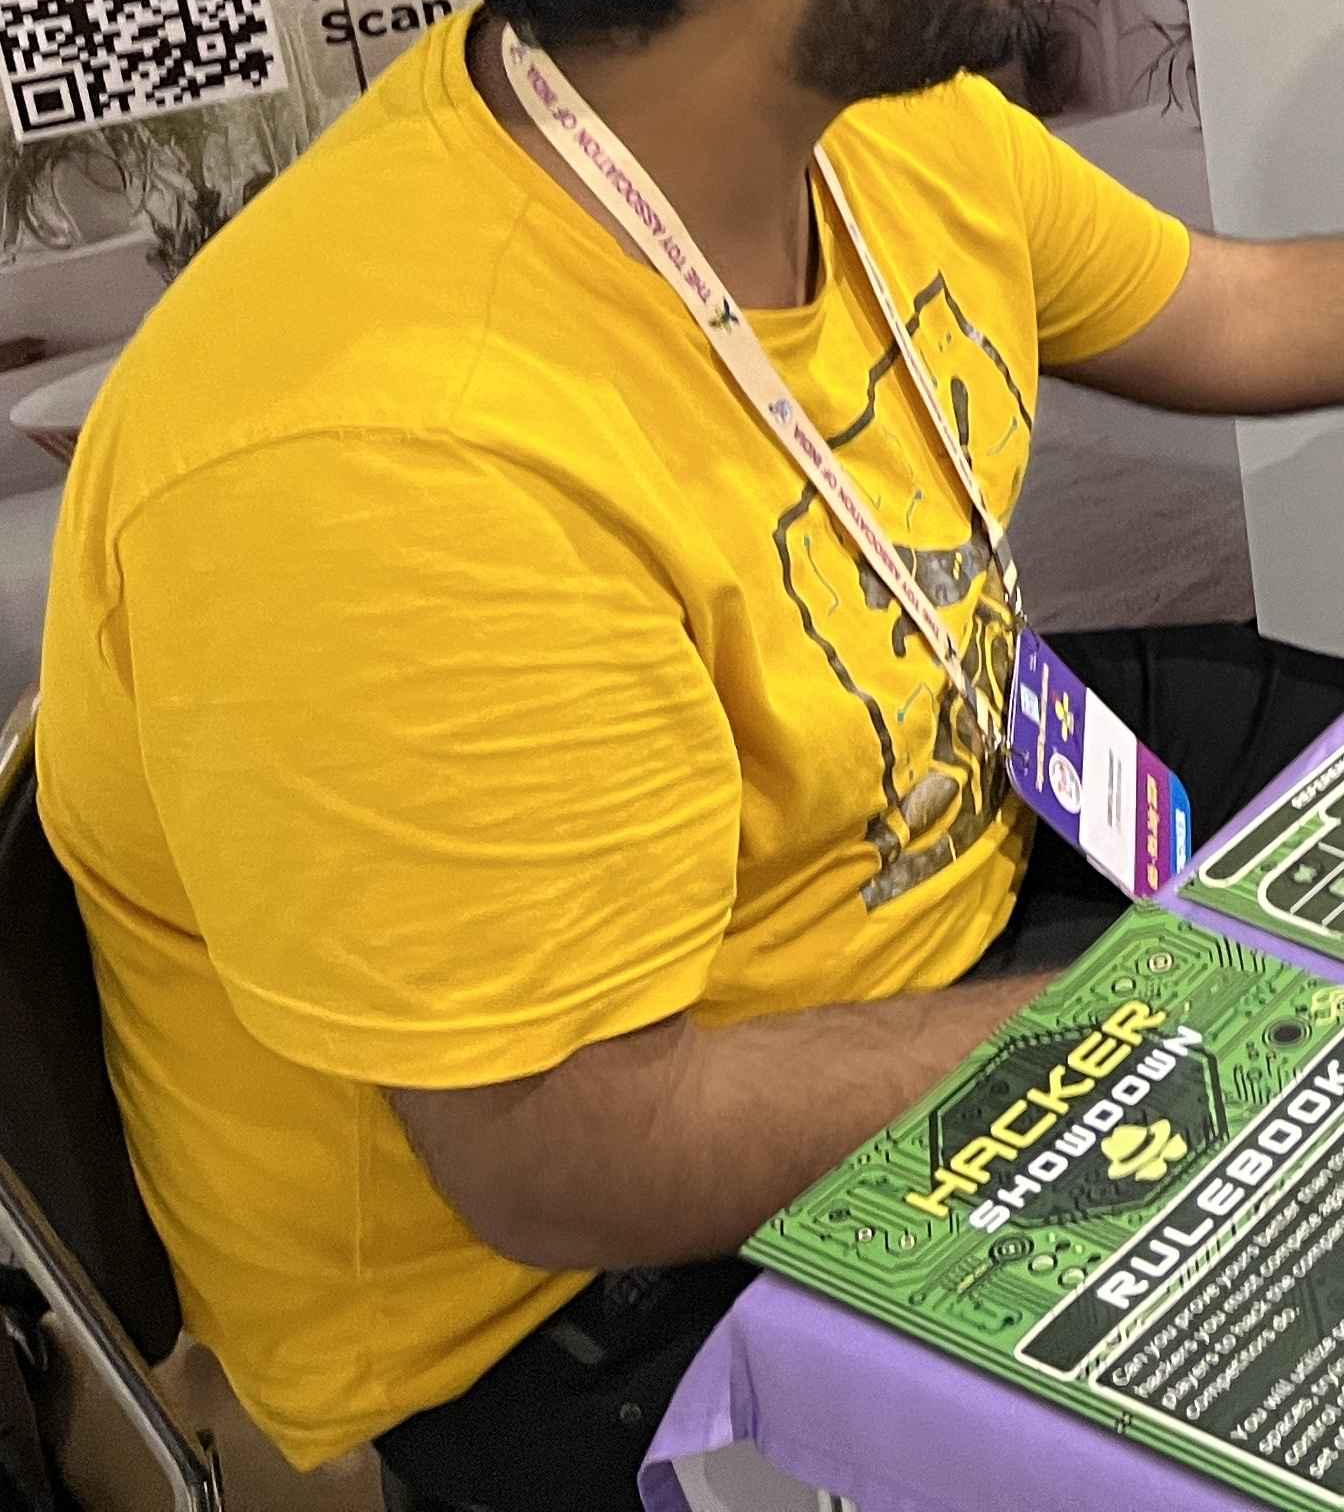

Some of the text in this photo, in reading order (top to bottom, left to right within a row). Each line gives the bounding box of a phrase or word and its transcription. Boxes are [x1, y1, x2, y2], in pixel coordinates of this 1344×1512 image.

[551, 106, 578, 129] OF
[576, 128, 667, 237] ASSOCIATION
[661, 235, 686, 271] TOY
[683, 266, 711, 305] THE
[908, 1000, 1164, 1219] HACKER
[969, 1024, 1202, 1233] SHOWDOWN
[1111, 1352, 1149, 1387] Can
[1143, 1324, 1178, 1360] you
[1173, 1283, 1221, 1331] prove
[1252, 1199, 1300, 1248] better
[1297, 1168, 1334, 1204] than
[1132, 1339, 1198, 1399] hackers
[1193, 1309, 1227, 1346] you
[1222, 1273, 1264, 1314] must
[1259, 1212, 1322, 1278] compete
[1161, 1351, 1220, 1411] players
[1214, 1333, 1237, 1354] to
[1229, 1299, 1272, 1337] hack
[1265, 1274, 1296, 1303] the
[1186, 1328, 1276, 1420] competitors
[1229, 1407, 1268, 1441] You
[1262, 1378, 1296, 1410] will
[1284, 1403, 1342, 1466] control
[1309, 1446, 1339, 1479] set
